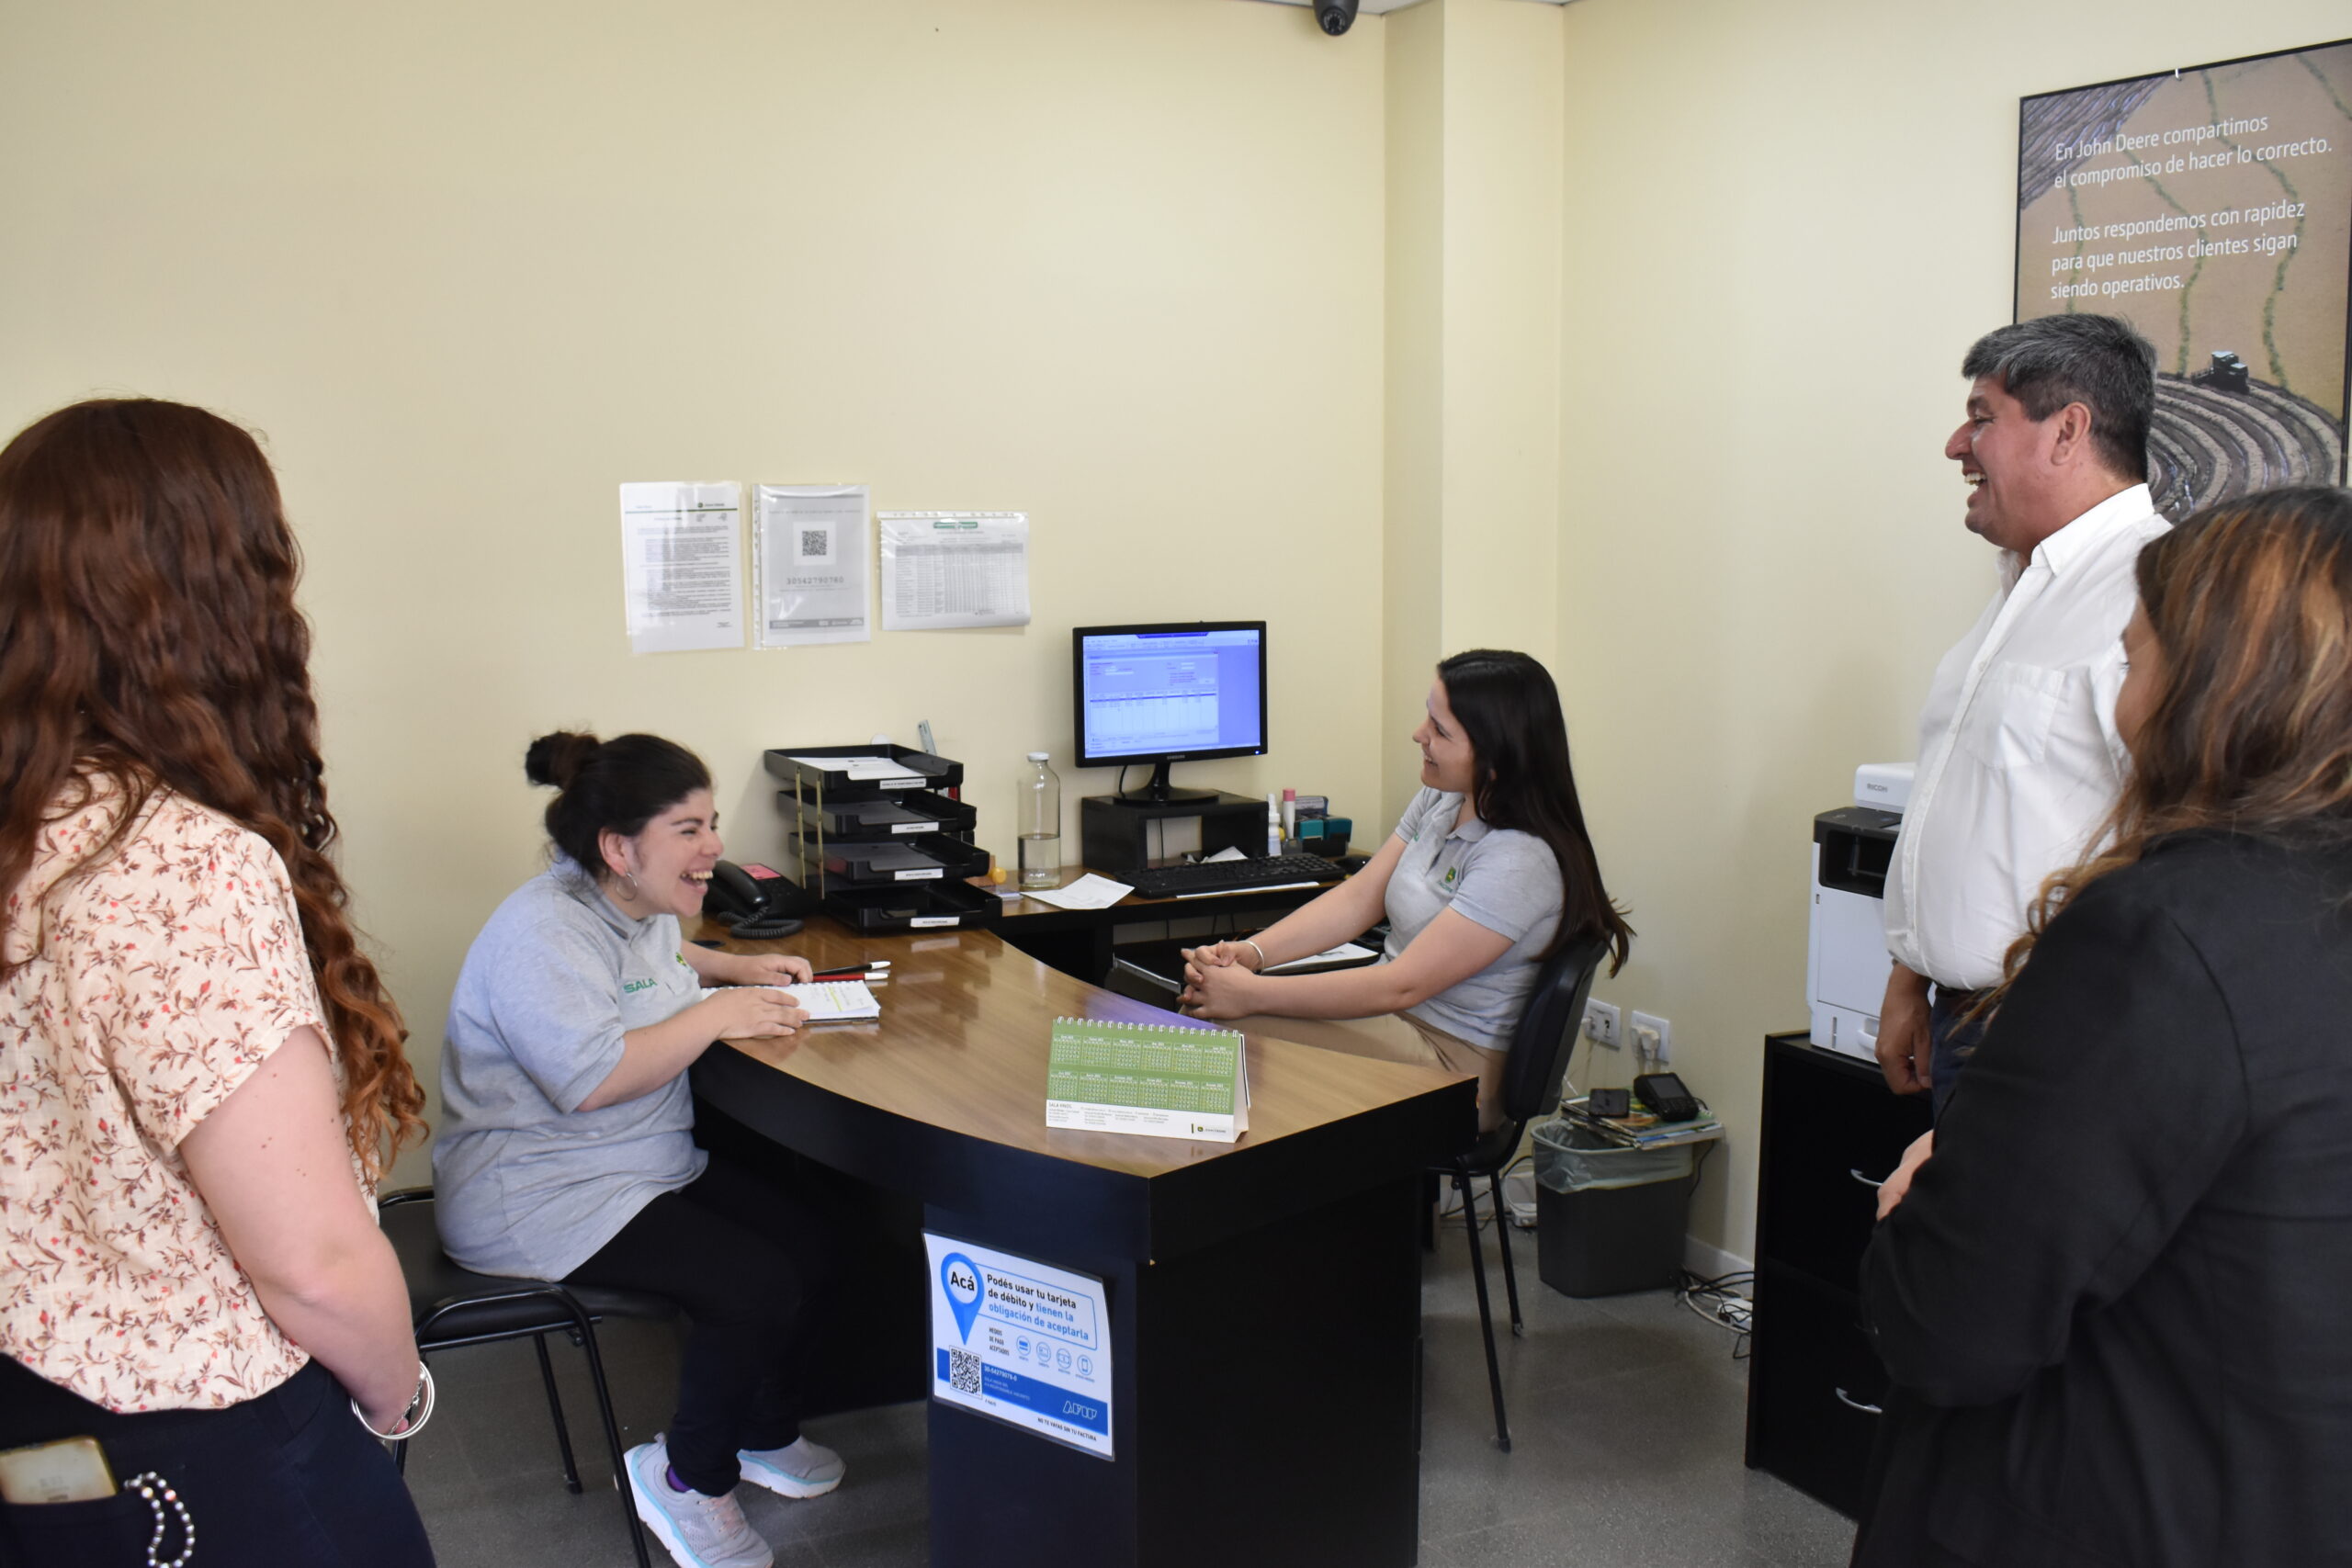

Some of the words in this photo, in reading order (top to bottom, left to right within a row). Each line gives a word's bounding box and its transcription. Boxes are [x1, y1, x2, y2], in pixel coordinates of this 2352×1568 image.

[2055, 142, 2073, 161] En
[2076, 138, 2111, 158] John
[2116, 133, 2159, 152] Deere
[2164, 117, 2268, 146] compartimos
[2054, 168, 2066, 188] el
[2070, 160, 2161, 187] compromiso
[2165, 154, 2184, 174] de
[2188, 151, 2233, 171] hacer
[2237, 145, 2252, 164] lo
[2256, 137, 2332, 161] correcto.
[2052, 225, 2100, 243] Juntos
[2104, 212, 2206, 241] respondemos
[2211, 210, 2239, 226] con
[2245, 198, 2305, 227] rapidez
[2052, 255, 2083, 276] para
[2086, 253, 2114, 273] que
[2118, 245, 2183, 265] nuestros
[2188, 238, 2249, 258] clientes
[2253, 232, 2297, 256] sigan
[2051, 277, 2098, 299] siendo
[2101, 274, 2185, 299] operativos.
[1866, 783, 1888, 793] RICOH
[623, 977, 658, 994] SALA
[951, 1271, 975, 1292] Acá
[987, 1274, 1012, 1290] Podés
[1015, 1284, 1034, 1296] usar
[1036, 1289, 1045, 1300] tu
[1047, 1292, 1076, 1309] tarjeta
[988, 1289, 999, 1299] de
[1001, 1292, 1027, 1307] débito
[1029, 1302, 1034, 1312] y
[1035, 1303, 1063, 1319] tienen
[1065, 1311, 1074, 1322] la
[989, 1303, 1032, 1323] obligación
[1035, 1315, 1045, 1326] de
[1046, 1321, 1089, 1340] aceptarla
[1078, 1430, 1097, 1441] FACTURA
